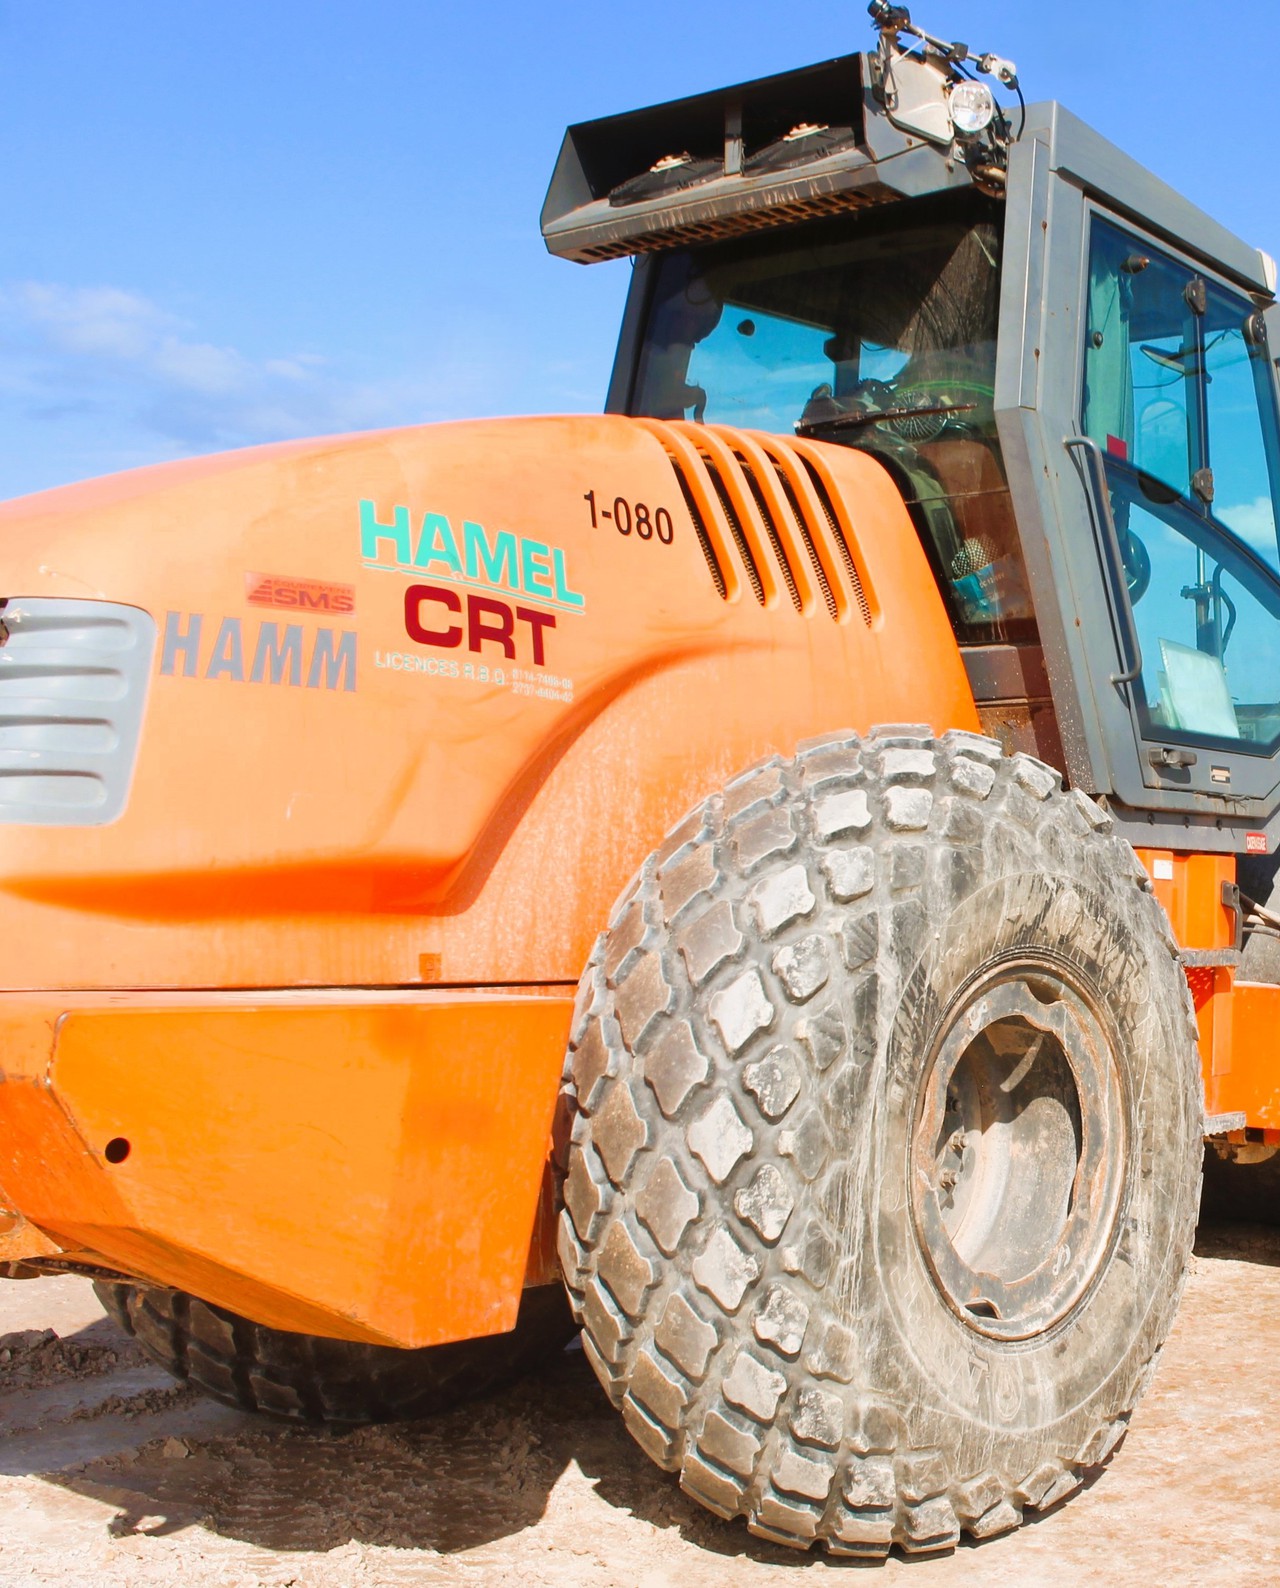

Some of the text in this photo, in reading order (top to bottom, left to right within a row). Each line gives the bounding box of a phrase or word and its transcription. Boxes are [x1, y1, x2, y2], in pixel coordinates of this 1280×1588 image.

[583, 490, 674, 545] 1-080
[358, 498, 585, 607] HAMEL
[274, 588, 354, 612] SMS
[403, 583, 557, 666] CRT
[159, 611, 358, 693] HAMM
[375, 650, 460, 678] LICENCES
